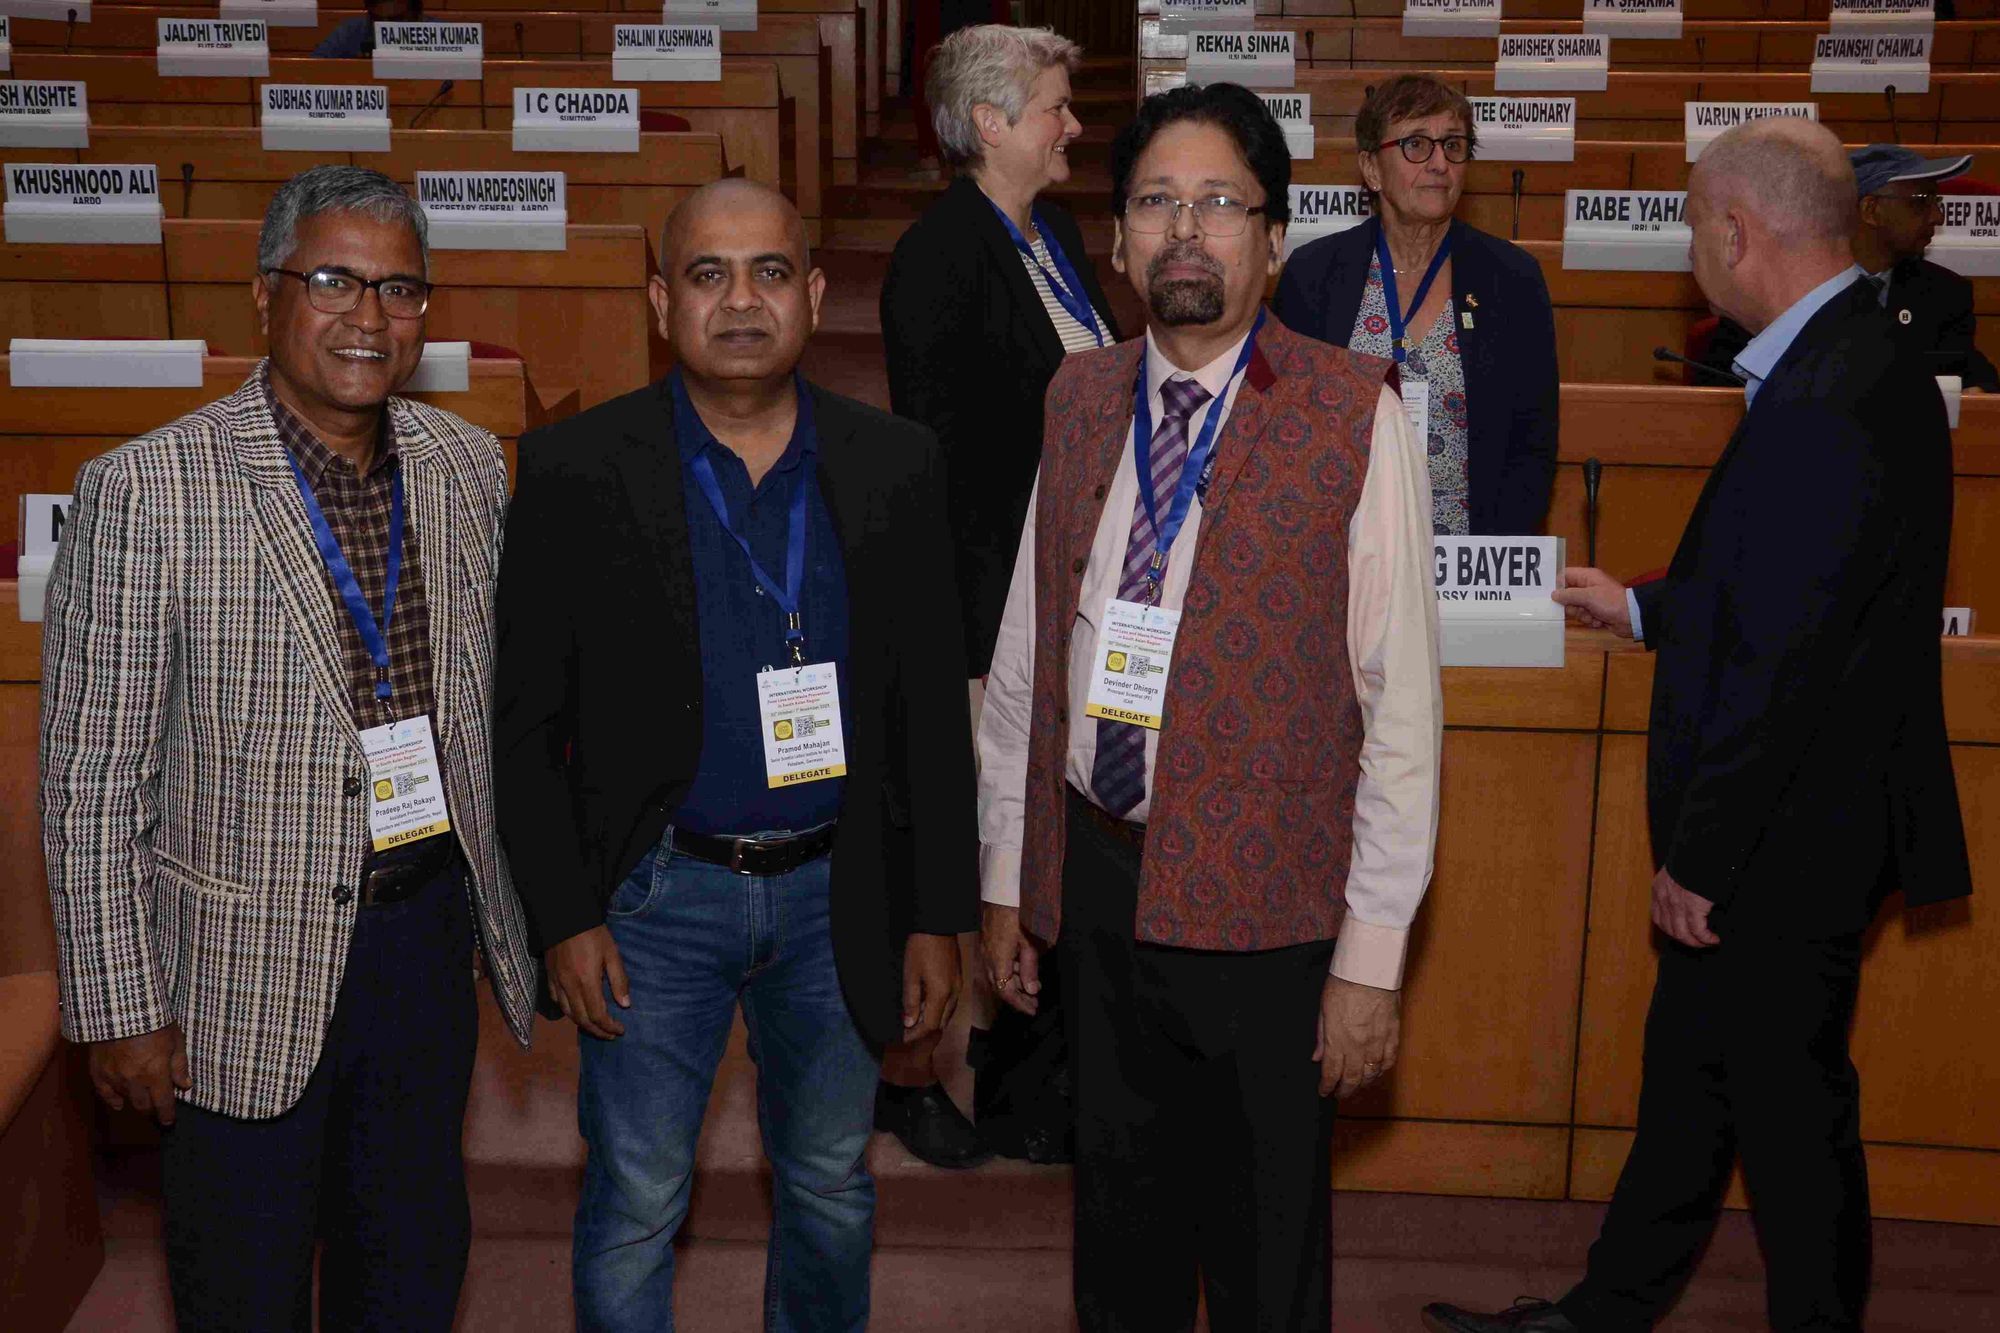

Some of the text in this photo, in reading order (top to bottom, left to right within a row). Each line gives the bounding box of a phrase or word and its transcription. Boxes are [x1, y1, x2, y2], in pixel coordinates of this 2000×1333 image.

[164, 24, 265, 42] JALDHI TRIVEDI
[381, 27, 479, 44] RAJNEESH KUMAR
[617, 29, 714, 47] SHALINI KUSHWAHA
[1196, 36, 1290, 53] REKHA SINHA
[1501, 38, 1602, 56] ABHISHEK SHARMA
[1817, 38, 1924, 58] DEVANSHI CHAWLA
[23, 86, 77, 107] KISHTE
[268, 89, 384, 110] SUBHAS KUMAR BASU
[526, 92, 629, 114] I C CHADDA
[1500, 102, 1571, 123] CHAUDHARY
[1696, 106, 1740, 126] VARUN
[13, 169, 156, 194] KHUSHNOOD ALI
[420, 178, 556, 202] MANOJ NARDEOSINGH
[72, 196, 102, 205] AARDO
[1300, 190, 1369, 216] KHARE
[1576, 196, 1631, 222] RABE
[1975, 202, 2000, 226] RAJ
[1970, 228, 1998, 237] NEPAL
[1457, 546, 1542, 586] BAYER
[1474, 590, 1512, 600] INDIA
[1146, 627, 1171, 636] WORKSHOP
[1104, 677, 1159, 695] Devinder Dhingra
[1101, 707, 1151, 723] DELEGATE
[777, 739, 831, 754] Pramod Mahajan
[783, 768, 831, 782] DELEGATE
[375, 795, 436, 817] Pradeep Raj Rokaya
[387, 825, 436, 844] DELEGATE
